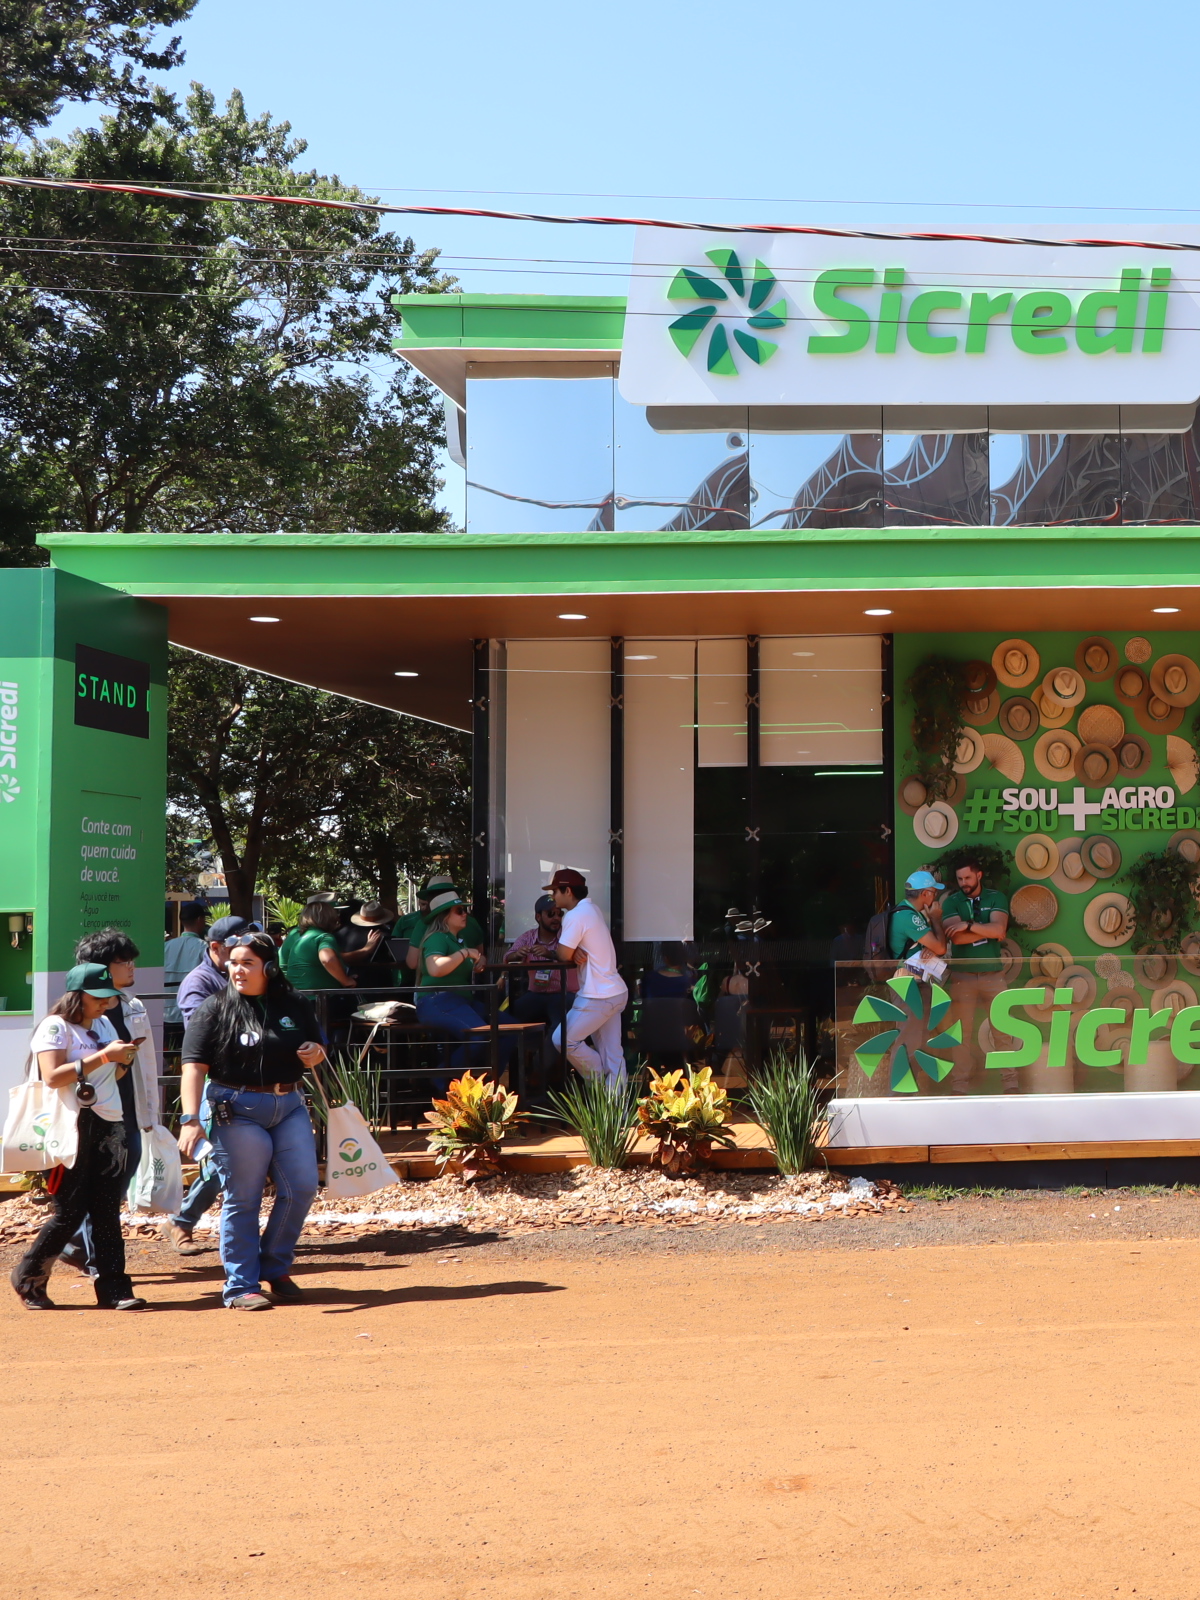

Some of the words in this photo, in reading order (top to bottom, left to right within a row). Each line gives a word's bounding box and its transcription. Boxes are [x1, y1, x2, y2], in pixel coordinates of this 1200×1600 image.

[807, 267, 1172, 355] Sicredi
[78, 673, 137, 708] STAND
[1101, 786, 1175, 809] AGRO
[81, 816, 110, 835] Conte
[112, 823, 132, 836] com
[81, 844, 109, 861] quem
[110, 843, 136, 860] cuida
[80, 865, 94, 882] de
[95, 866, 120, 883] você.
[108, 893, 120, 902] tem
[332, 1162, 377, 1179] e-agro
